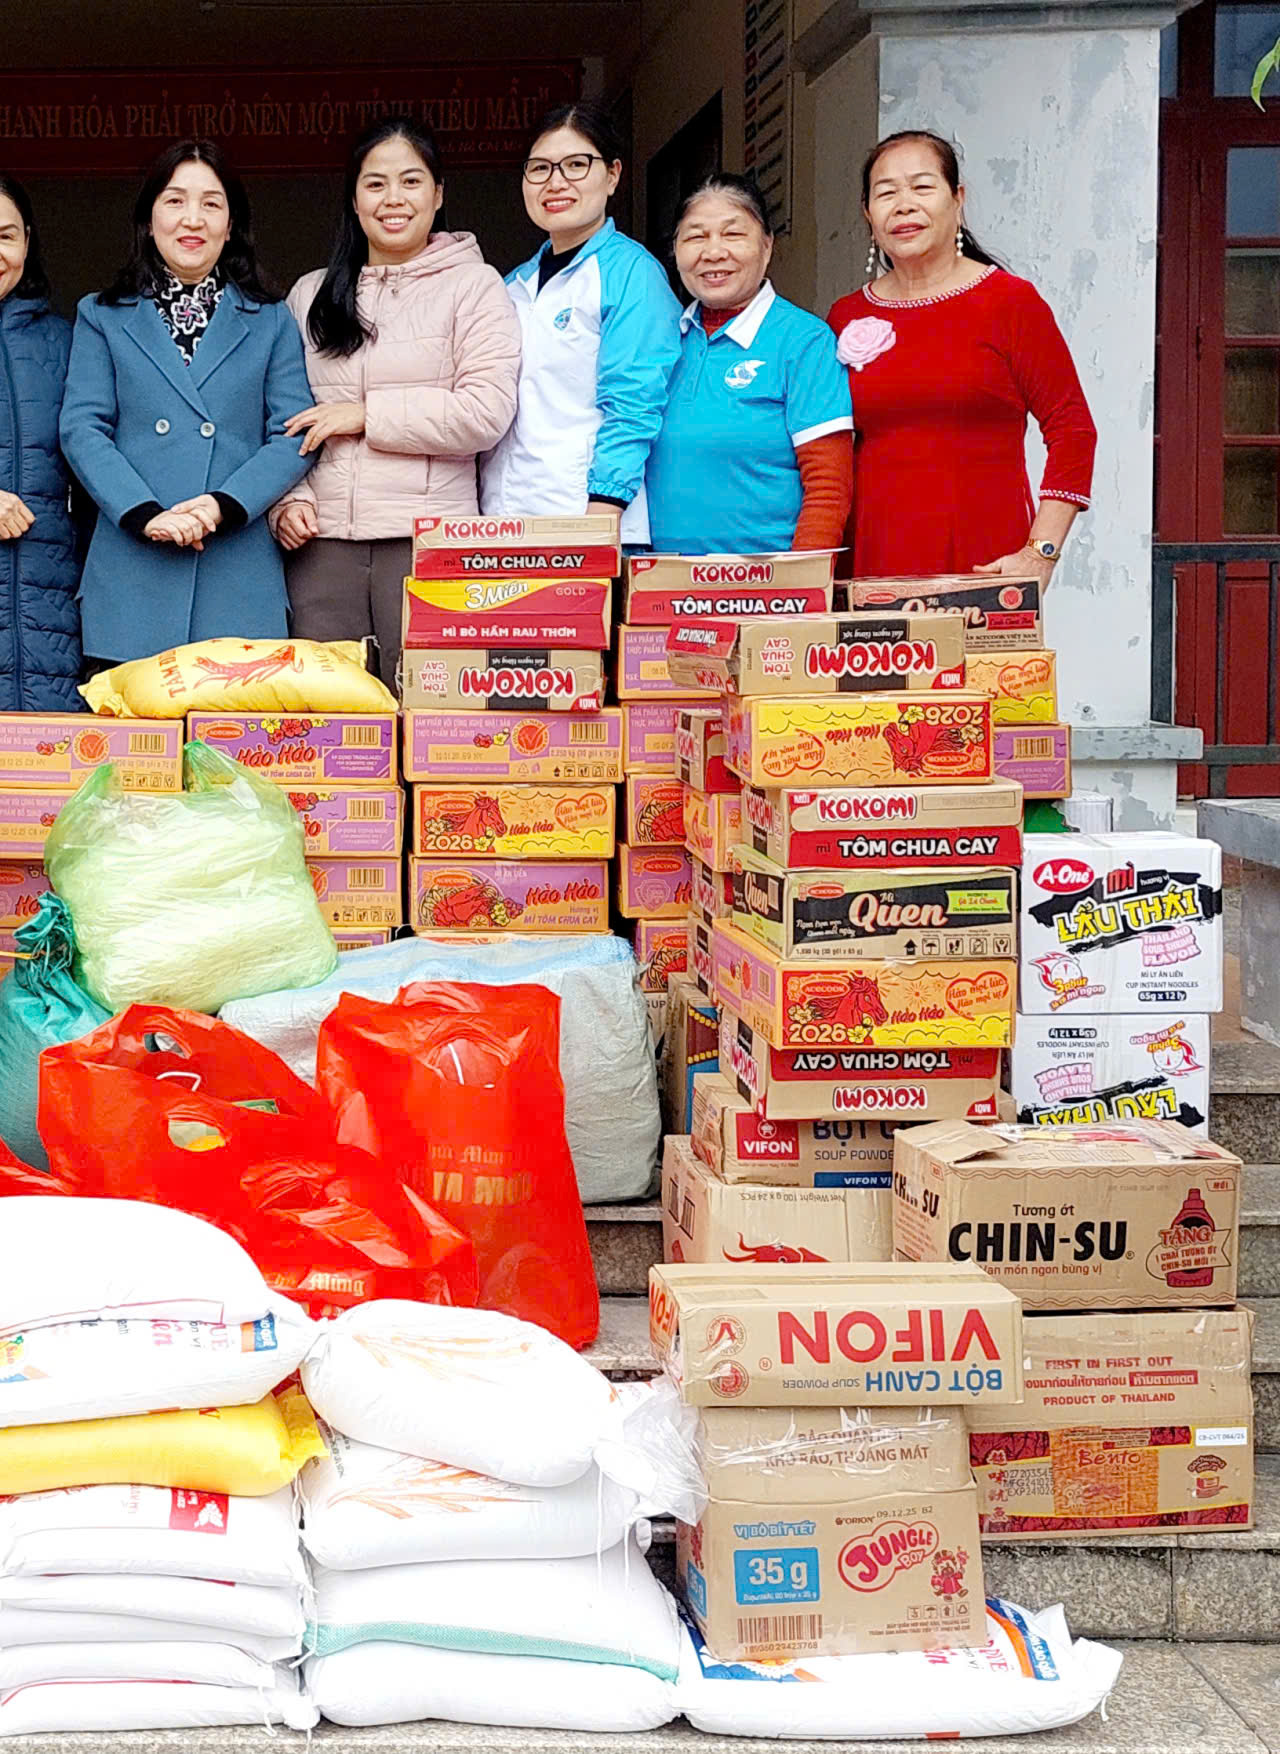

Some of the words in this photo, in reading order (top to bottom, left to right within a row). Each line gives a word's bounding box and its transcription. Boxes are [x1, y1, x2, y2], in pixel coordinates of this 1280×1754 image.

[243, 92, 293, 136] NÊN
[444, 520, 522, 539] KOKOMI
[462, 552, 499, 570] TÔM
[502, 555, 548, 570] CHUA
[550, 554, 585, 569] CAY
[691, 563, 773, 583] KOKOMI
[555, 585, 586, 597] GOLD
[671, 596, 710, 615] TÔM
[712, 599, 767, 614] CHUA
[770, 598, 808, 613] CAY
[442, 626, 457, 638] MÌ
[459, 624, 477, 638] BÒ
[513, 627, 538, 639] RAU
[540, 626, 577, 638] THƠM
[808, 641, 934, 677] KOKOMI
[461, 668, 573, 697] KOKOMI
[925, 706, 983, 725] 2026
[818, 795, 916, 820] KOKOMI
[426, 835, 473, 850] 2026
[838, 836, 890, 858] TÔM
[892, 839, 953, 857] CHUA
[956, 837, 999, 855] CAY
[1036, 863, 1091, 885] A-One
[848, 891, 948, 929] Quen
[1123, 884, 1199, 928] THÁI
[788, 1023, 846, 1044] 2026
[835, 1086, 926, 1110] KOKOMI
[744, 1140, 794, 1154] VIFON
[814, 1149, 847, 1161] SOUP
[850, 1149, 893, 1161] POWDE
[1012, 1203, 1057, 1219] Tương
[1060, 1203, 1075, 1217] ớt
[948, 1221, 1128, 1263] CHIN-SU
[1003, 1263, 1029, 1276] món
[1031, 1265, 1059, 1279] ngon
[1061, 1262, 1089, 1279] bùng
[777, 1308, 1001, 1365] VIFON
[1045, 1358, 1081, 1370] FIRST
[1087, 1358, 1100, 1369] IN
[1106, 1357, 1141, 1368] FIRST
[1148, 1356, 1173, 1367] OUT
[781, 1378, 825, 1391] POWDER
[827, 1377, 860, 1389] SOUP
[865, 1369, 942, 1393] CANH
[947, 1362, 1002, 1398] BỘT
[1043, 1395, 1097, 1406] PRODUCT
[1101, 1394, 1116, 1404] OF
[1121, 1392, 1176, 1403] THAILAND
[900, 1446, 930, 1460] MÁT
[1077, 1448, 1141, 1468] Bento
[876, 1507, 917, 1519] 09.12.25
[845, 1527, 933, 1583] JUNGLE
[748, 1556, 785, 1586] 35
[790, 1561, 808, 1590] g
